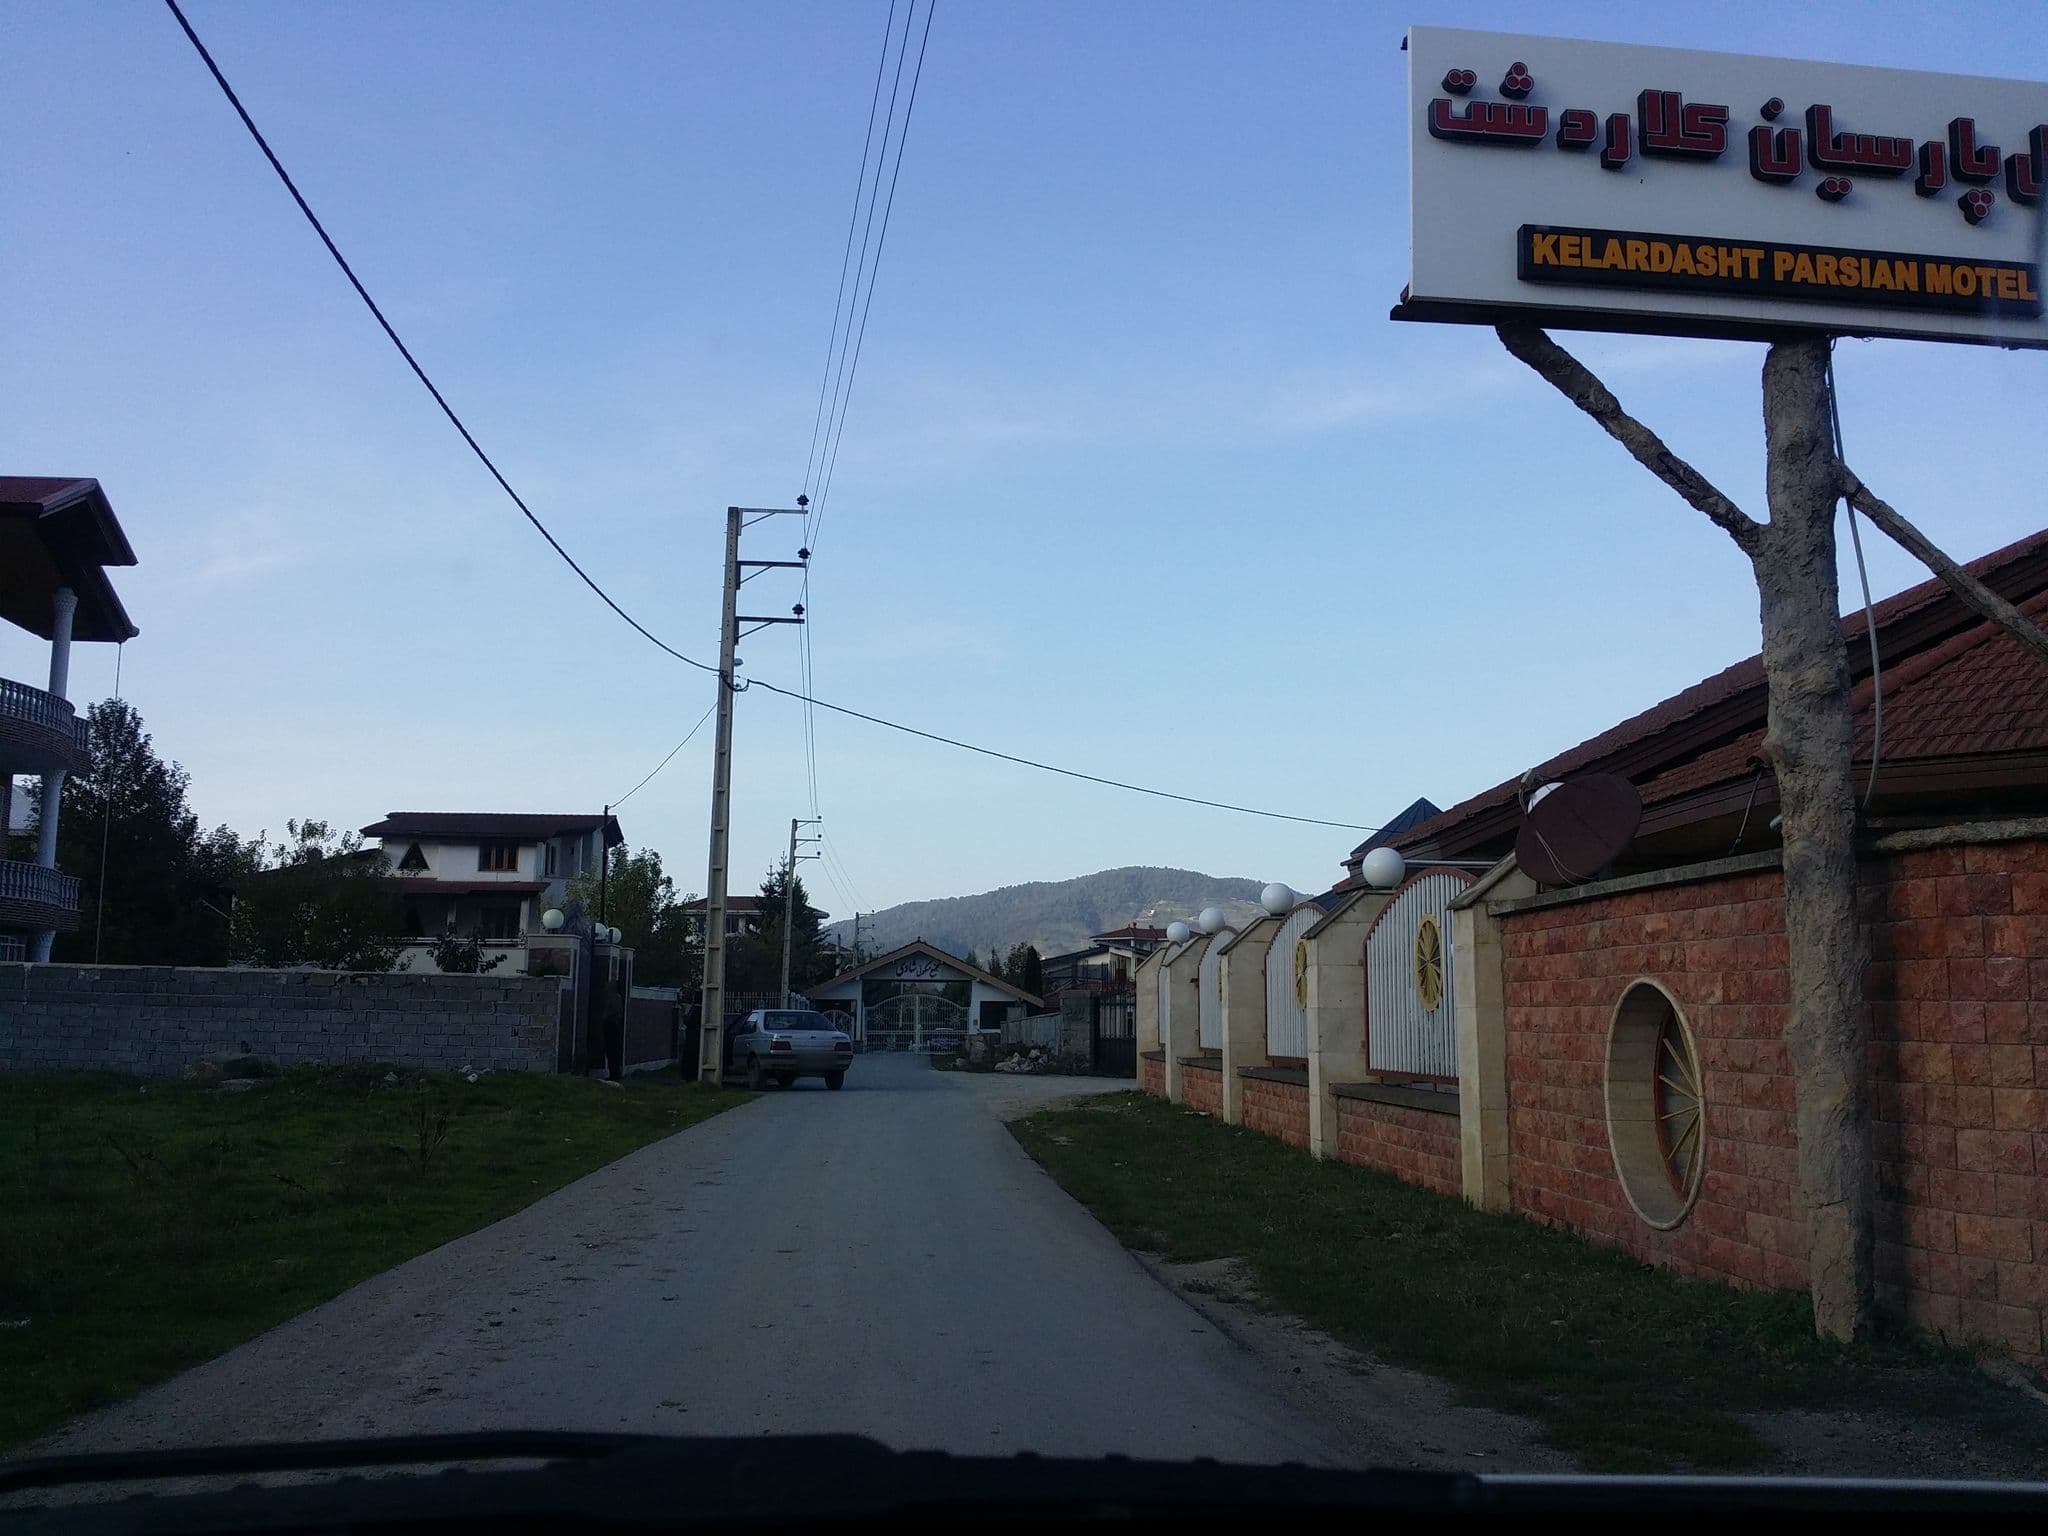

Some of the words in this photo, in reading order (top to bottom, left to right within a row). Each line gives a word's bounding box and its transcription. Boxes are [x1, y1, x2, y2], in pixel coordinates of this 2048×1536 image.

[1428, 61, 1730, 170] کلاردشت
[1749, 96, 2001, 226] پارسیان
[1532, 232, 1765, 280] KELARDASHT
[1773, 250, 1918, 292] PARSIAN
[1925, 262, 2038, 301] MOTEL
